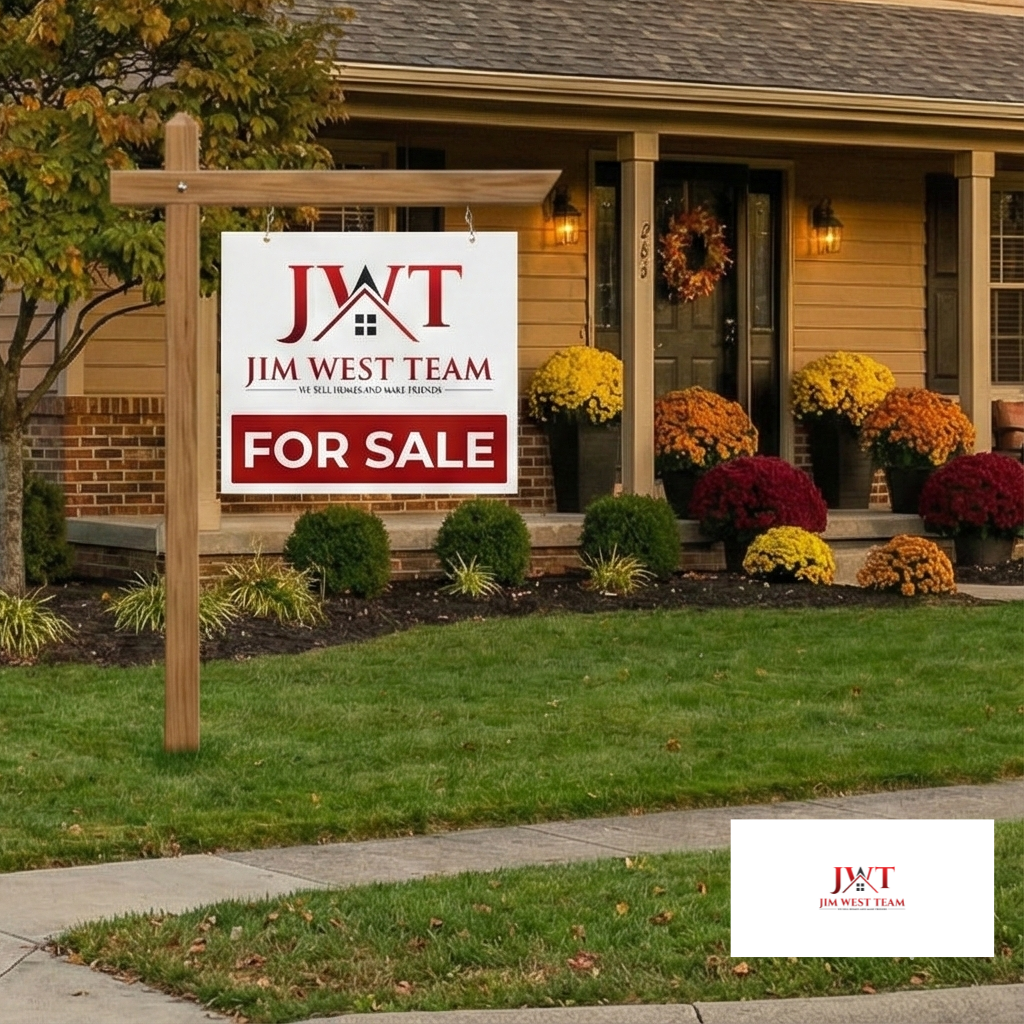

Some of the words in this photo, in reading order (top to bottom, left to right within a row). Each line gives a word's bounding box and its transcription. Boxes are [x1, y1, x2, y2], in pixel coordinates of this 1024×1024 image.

[276, 264, 463, 344] JWT
[245, 356, 300, 388] JIM
[307, 356, 394, 381] WEST
[402, 356, 493, 381] TEAM
[298, 385, 311, 394] WE
[313, 385, 332, 394] SELL
[244, 430, 349, 469] FOR
[365, 430, 495, 469] SALE
